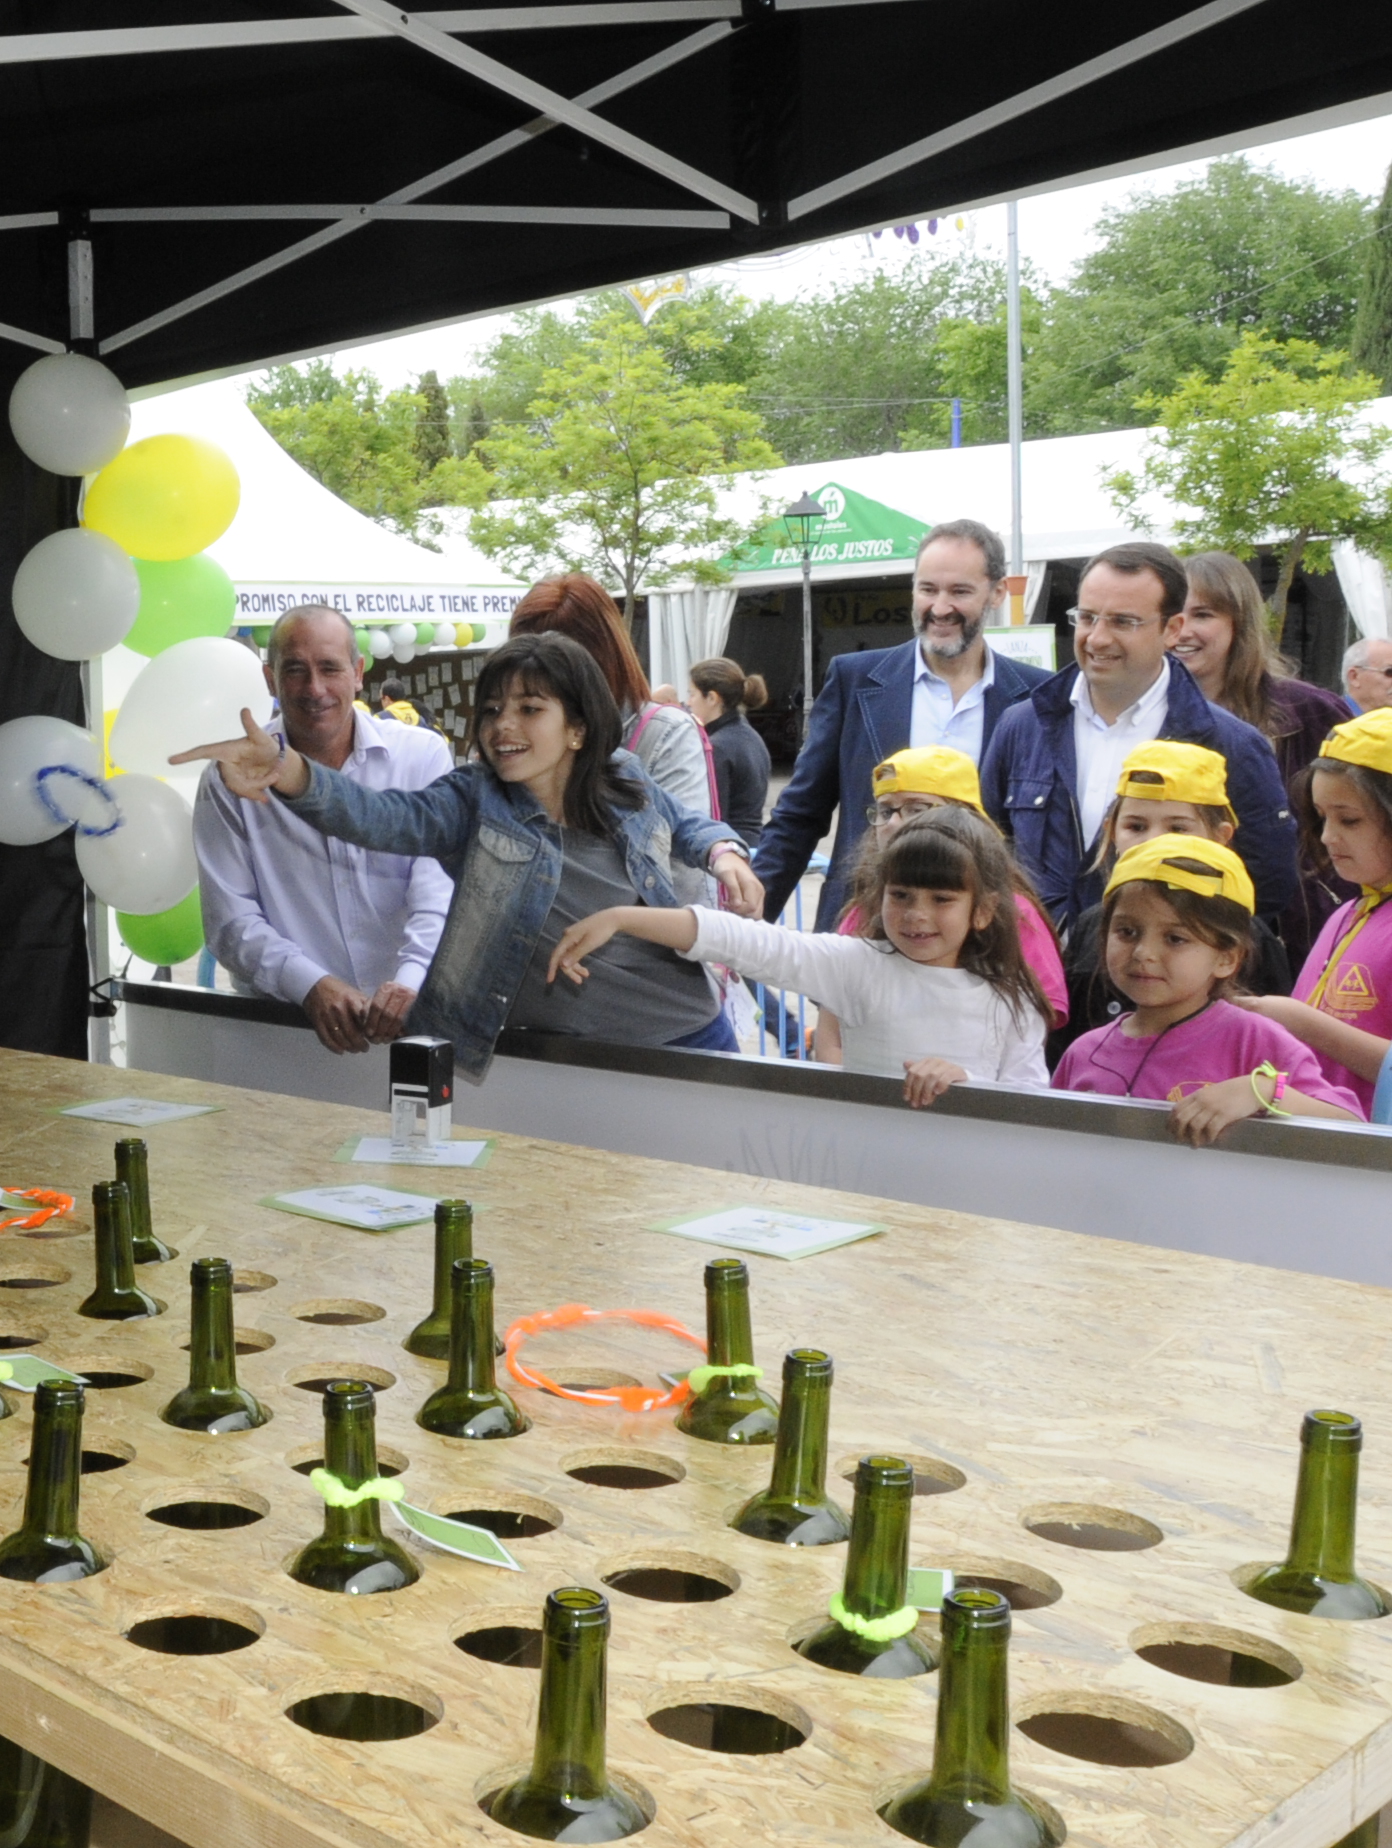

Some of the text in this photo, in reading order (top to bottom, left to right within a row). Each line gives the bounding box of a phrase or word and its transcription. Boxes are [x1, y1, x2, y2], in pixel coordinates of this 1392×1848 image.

[810, 543, 838, 561] LOS
[838, 538, 893, 560] JUSTOS
[334, 594, 352, 612] EL
[356, 593, 435, 612] RECICLAJE
[439, 594, 479, 613] TIENE
[483, 595, 522, 612] PREM
